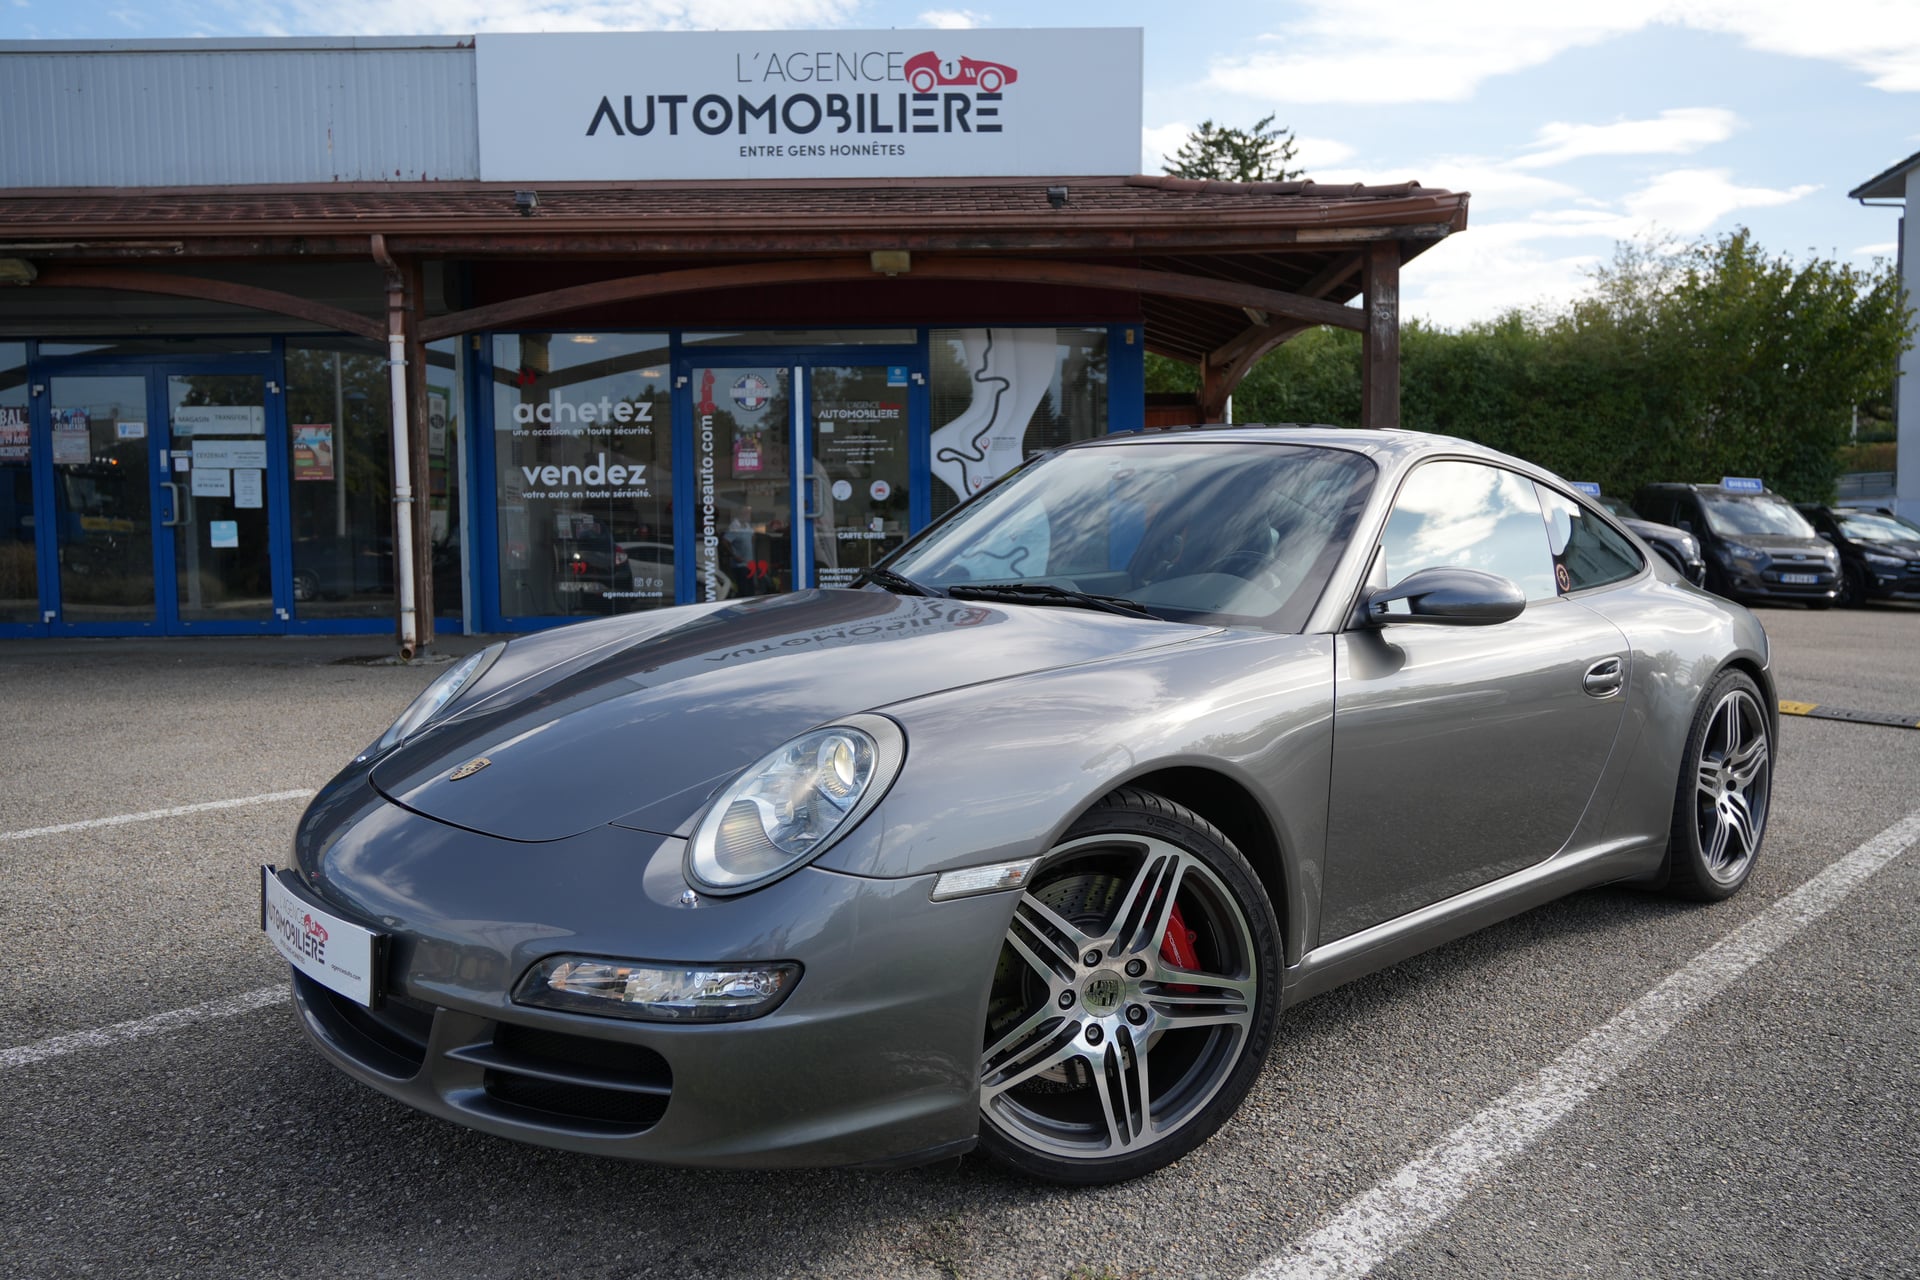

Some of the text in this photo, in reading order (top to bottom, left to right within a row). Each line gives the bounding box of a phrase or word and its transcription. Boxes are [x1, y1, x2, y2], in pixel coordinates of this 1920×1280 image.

[737, 51, 905, 83] L'AGENCE
[585, 92, 1003, 136] AUTOMOBILIERE
[739, 141, 905, 158] ENTRE GENS HONNÊTES
[512, 390, 653, 423] achetez
[818, 409, 900, 419] AUTOMOBILIERE
[512, 429, 529, 437] une
[531, 428, 570, 436] occasion
[587, 427, 611, 436] toute
[614, 425, 653, 436] sécurité.
[521, 452, 646, 486] vendez
[521, 491, 546, 499] votre
[586, 490, 610, 498] toute
[613, 488, 651, 498] sérénité.
[700, 415, 718, 603] www.agenceauto.com
[602, 590, 663, 600] agenceauto.com
